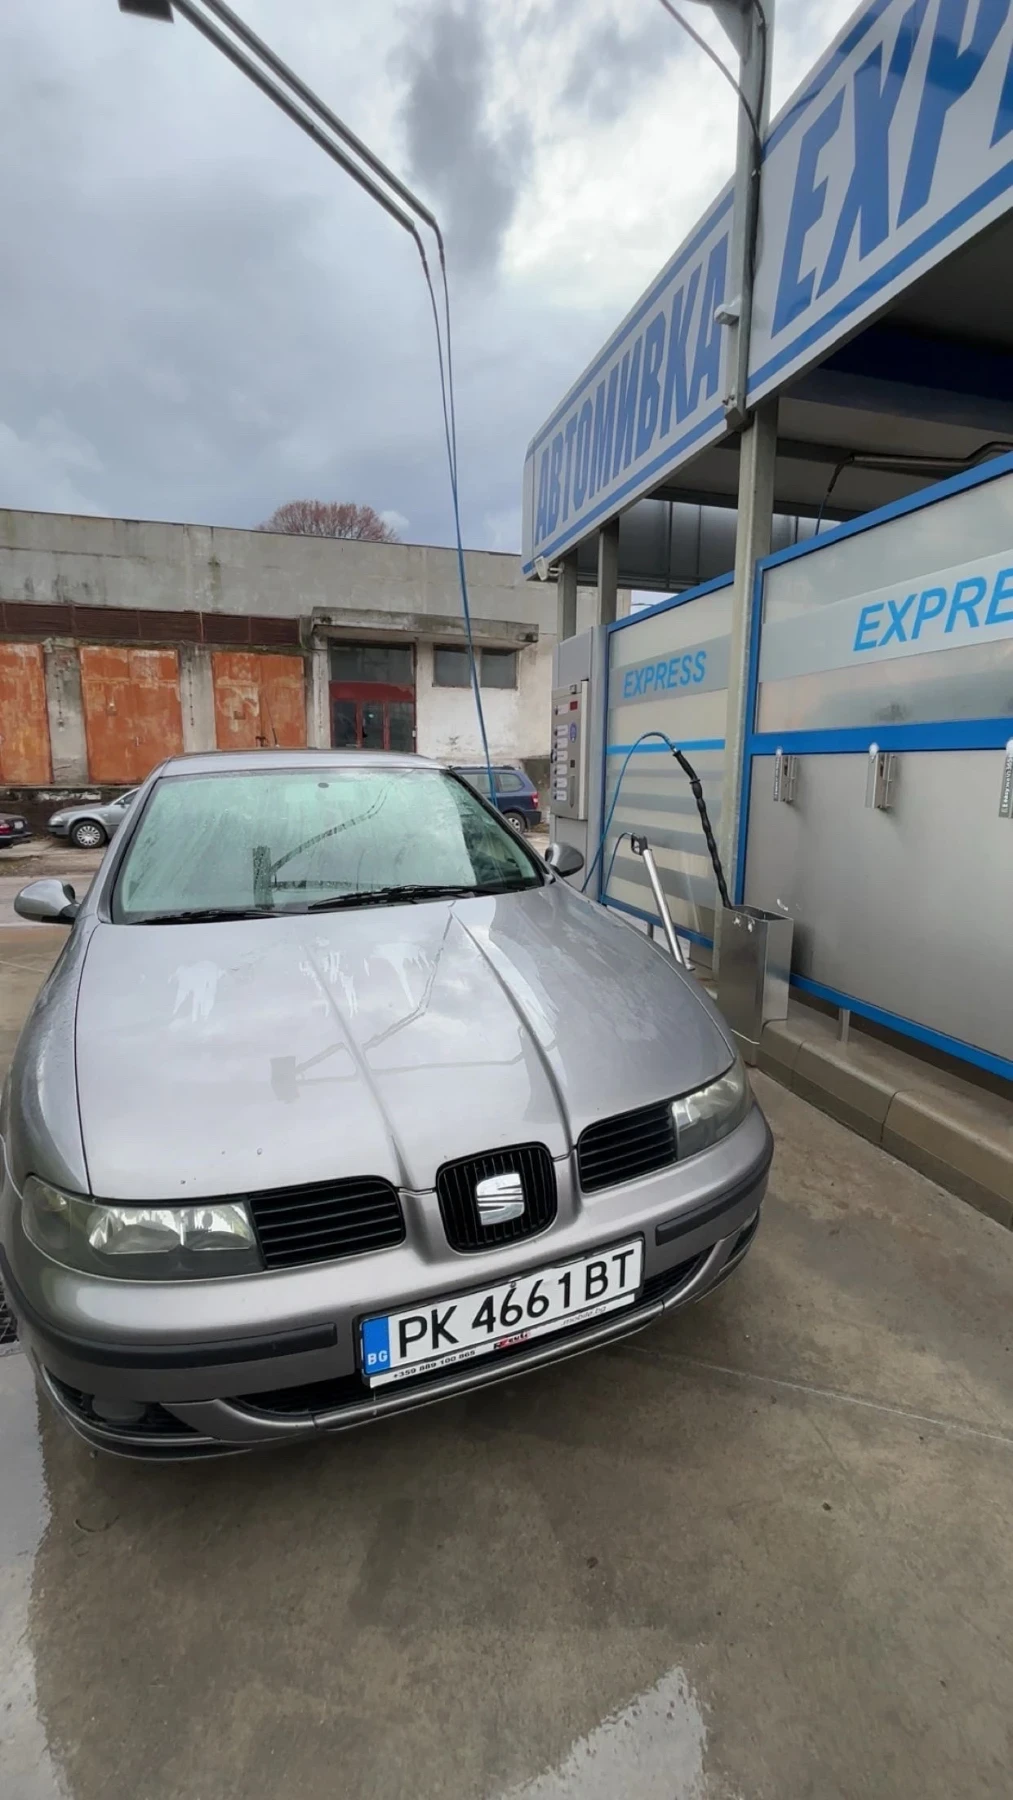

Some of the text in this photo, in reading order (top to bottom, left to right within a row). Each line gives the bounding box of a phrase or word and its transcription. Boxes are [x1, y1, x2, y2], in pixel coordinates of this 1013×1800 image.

[535, 231, 728, 546] АВТОМИВКА
[623, 651, 707, 699] EXPRESS
[399, 1249, 635, 1358] PK 4661 BT
[367, 1350, 388, 1366] BG
[393, 1368, 416, 1378] +359
